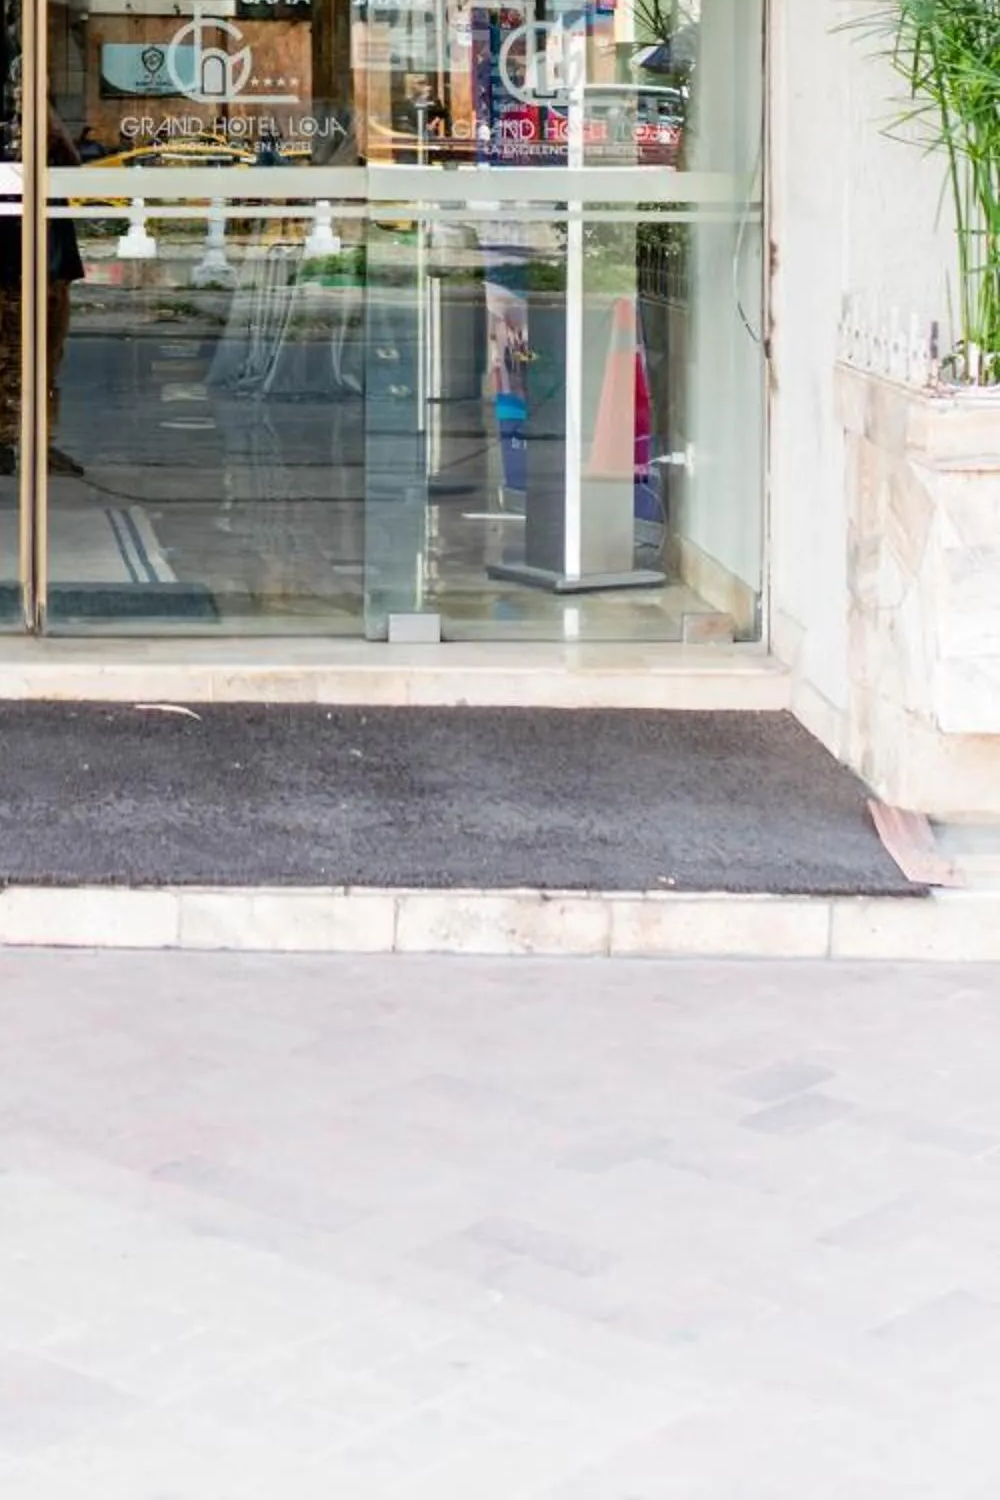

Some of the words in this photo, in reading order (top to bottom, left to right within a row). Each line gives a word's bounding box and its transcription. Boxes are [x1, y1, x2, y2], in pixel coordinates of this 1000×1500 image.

[119, 115, 203, 138] GRAND
[212, 116, 280, 138] HOTEL
[288, 116, 348, 138] LOJA
